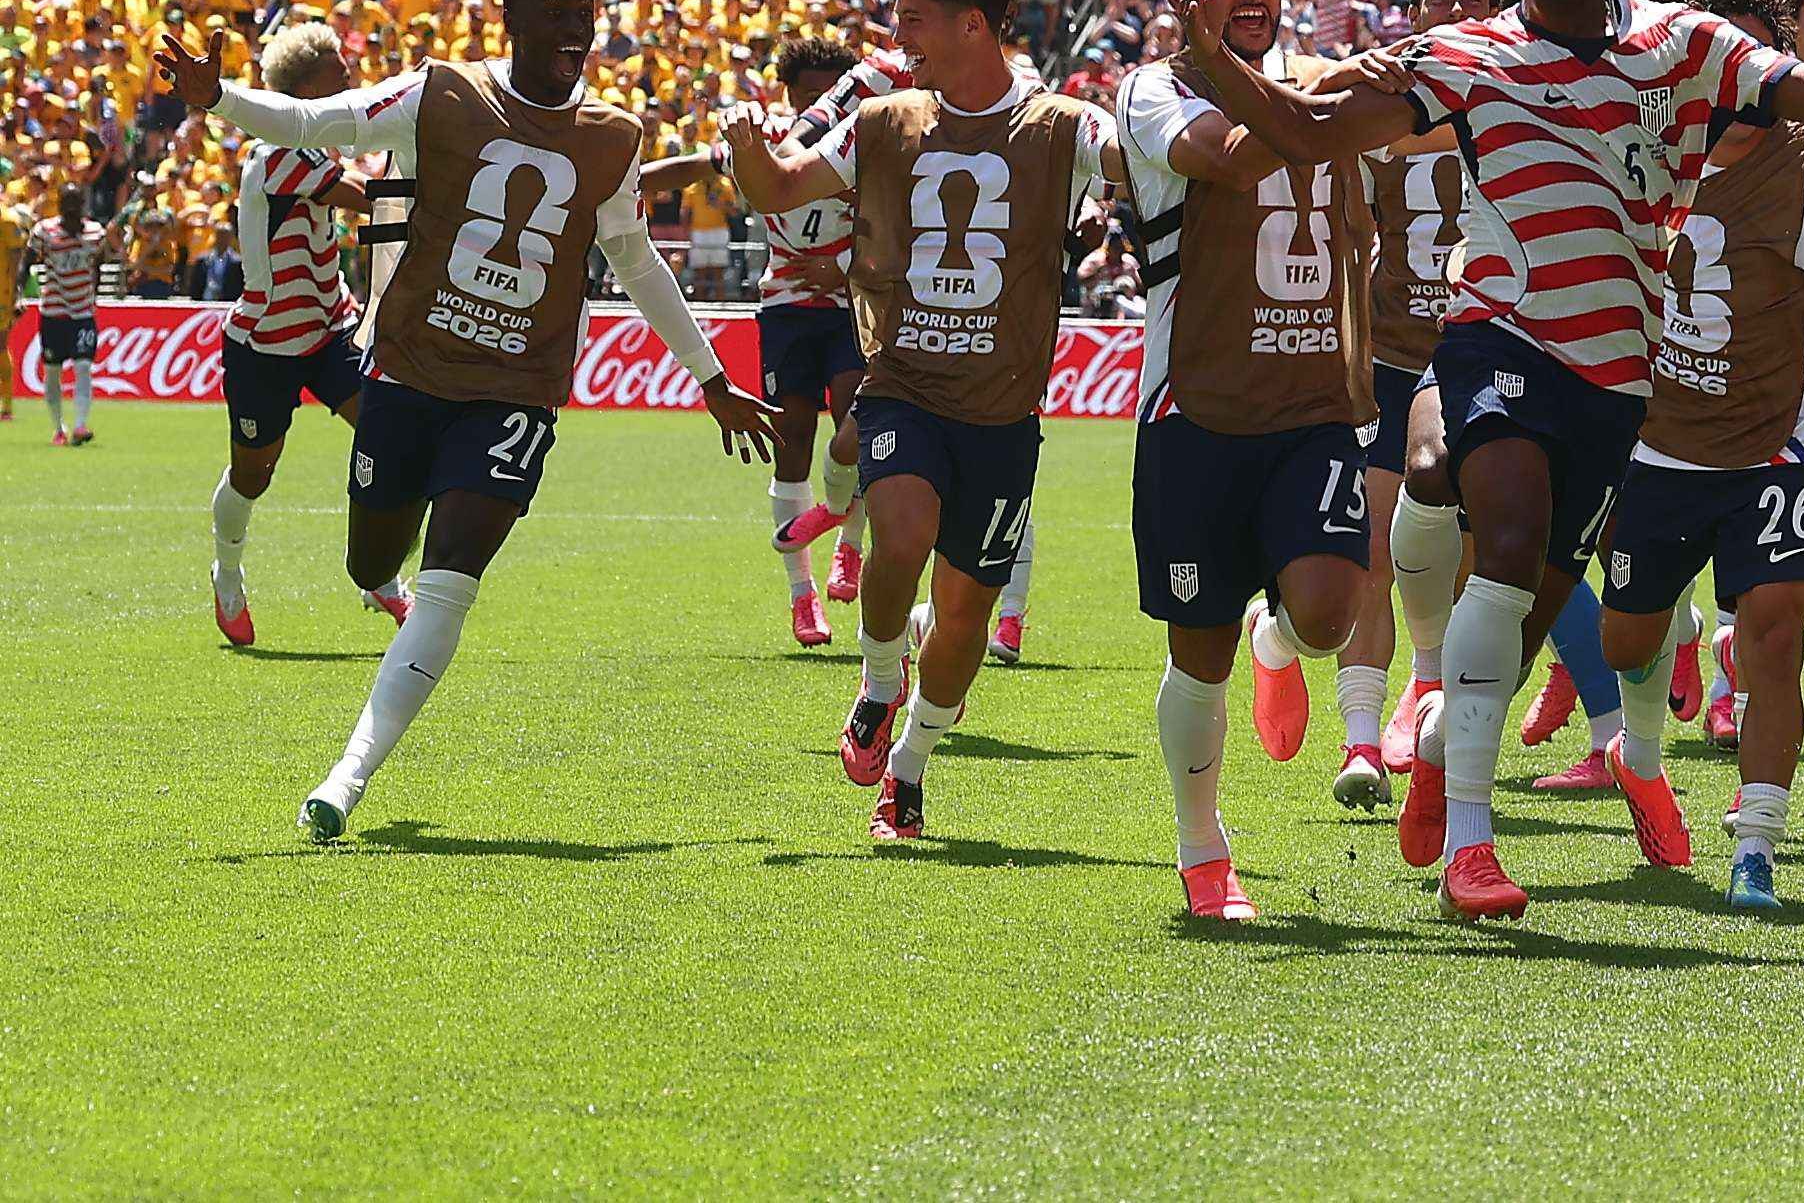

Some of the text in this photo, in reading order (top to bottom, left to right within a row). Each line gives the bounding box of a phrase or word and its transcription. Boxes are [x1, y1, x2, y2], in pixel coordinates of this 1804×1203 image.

[1640, 89, 1669, 109] USA
[802, 209, 823, 243] 4
[473, 266, 520, 294] FIFA
[932, 276, 976, 294] FIFA
[1286, 265, 1320, 283] FIFA
[436, 289, 533, 331] WORLD CUP
[902, 308, 998, 329] WORLD CUP
[1254, 307, 1334, 325] WORLD CUP
[426, 306, 528, 355] 2026
[896, 325, 994, 354] 2026
[1251, 327, 1338, 354] 2026
[1658, 342, 1731, 374] ORLD CUP
[1496, 371, 1523, 385] USA
[1653, 356, 1727, 396] 026
[487, 411, 547, 470] 21
[873, 431, 895, 446] USA
[1318, 459, 1366, 521] 15
[981, 496, 1030, 551] 14
[1171, 564, 1196, 580] USA
[1612, 551, 1630, 568] USA
